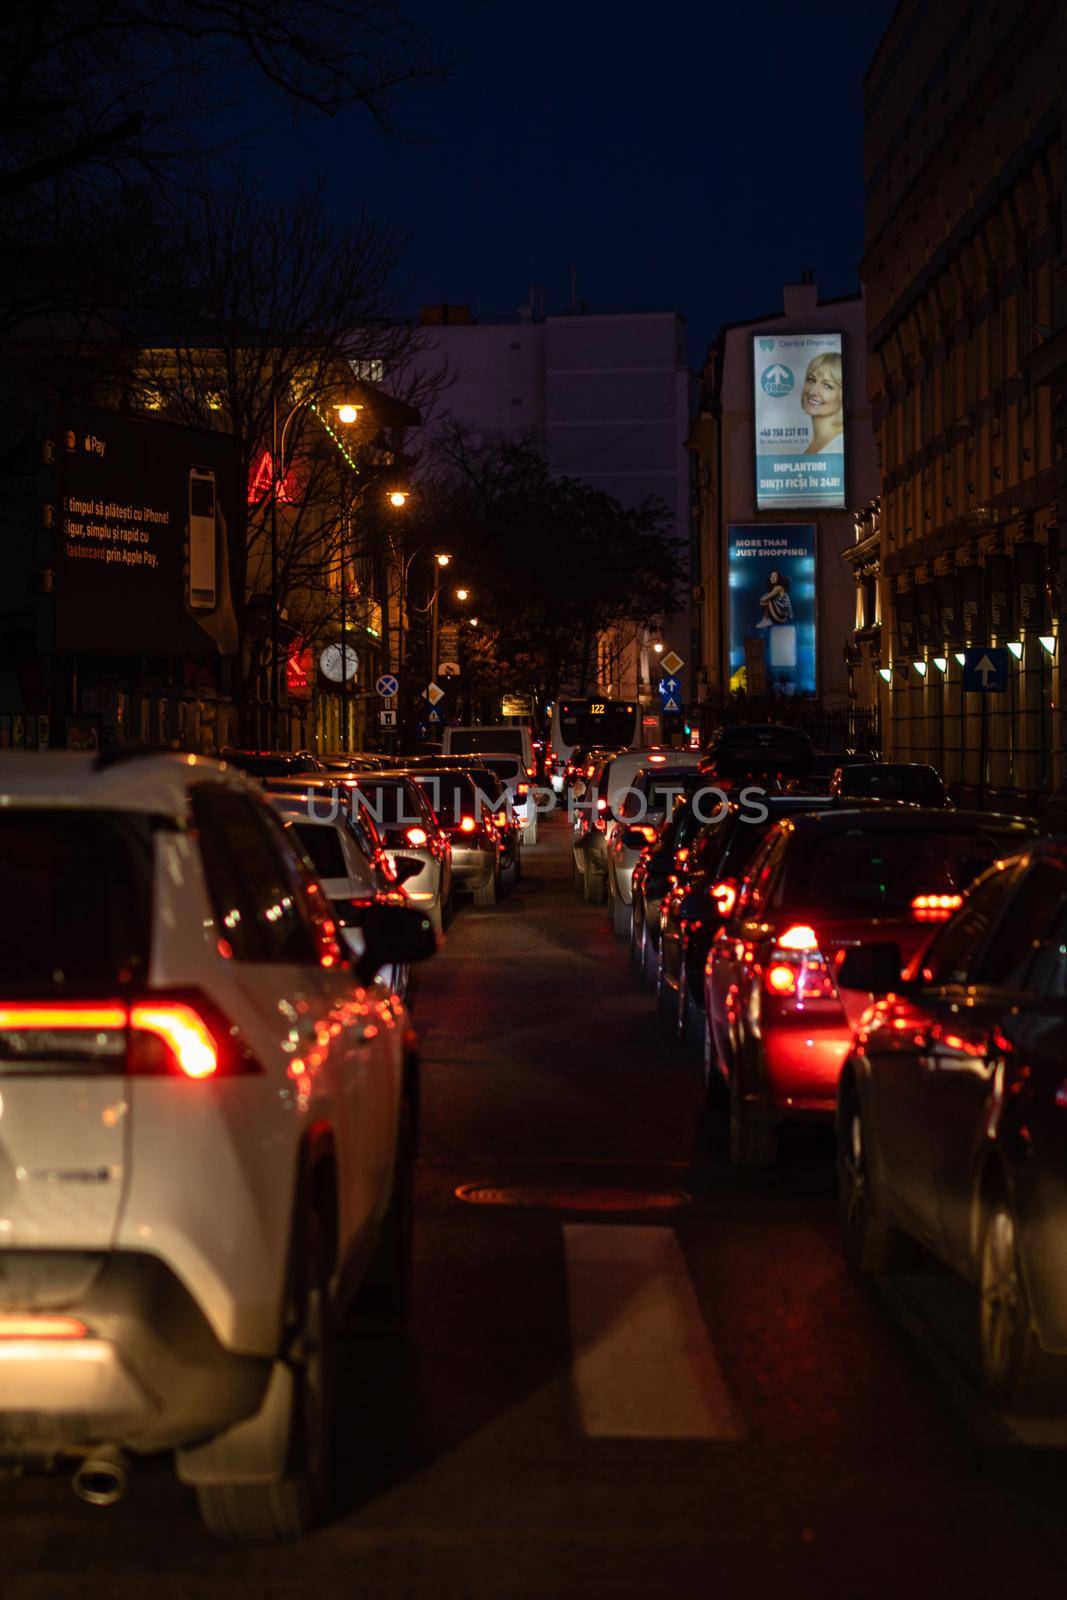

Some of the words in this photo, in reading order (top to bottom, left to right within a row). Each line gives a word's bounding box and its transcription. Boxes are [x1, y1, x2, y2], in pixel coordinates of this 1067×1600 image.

[773, 462, 827, 472] IMPLANTURI
[69, 497, 94, 517] timpul
[133, 509, 143, 521] cu
[86, 522, 111, 541] simplu
[120, 528, 139, 544] rapid
[139, 531, 149, 543] cu
[735, 539, 762, 547] MORE
[65, 543, 105, 560] astercard
[106, 547, 121, 564] prin
[122, 549, 143, 566] Apple
[735, 549, 758, 557] JUST
[758, 548, 808, 556] SHOPPING!
[591, 704, 605, 714] 122
